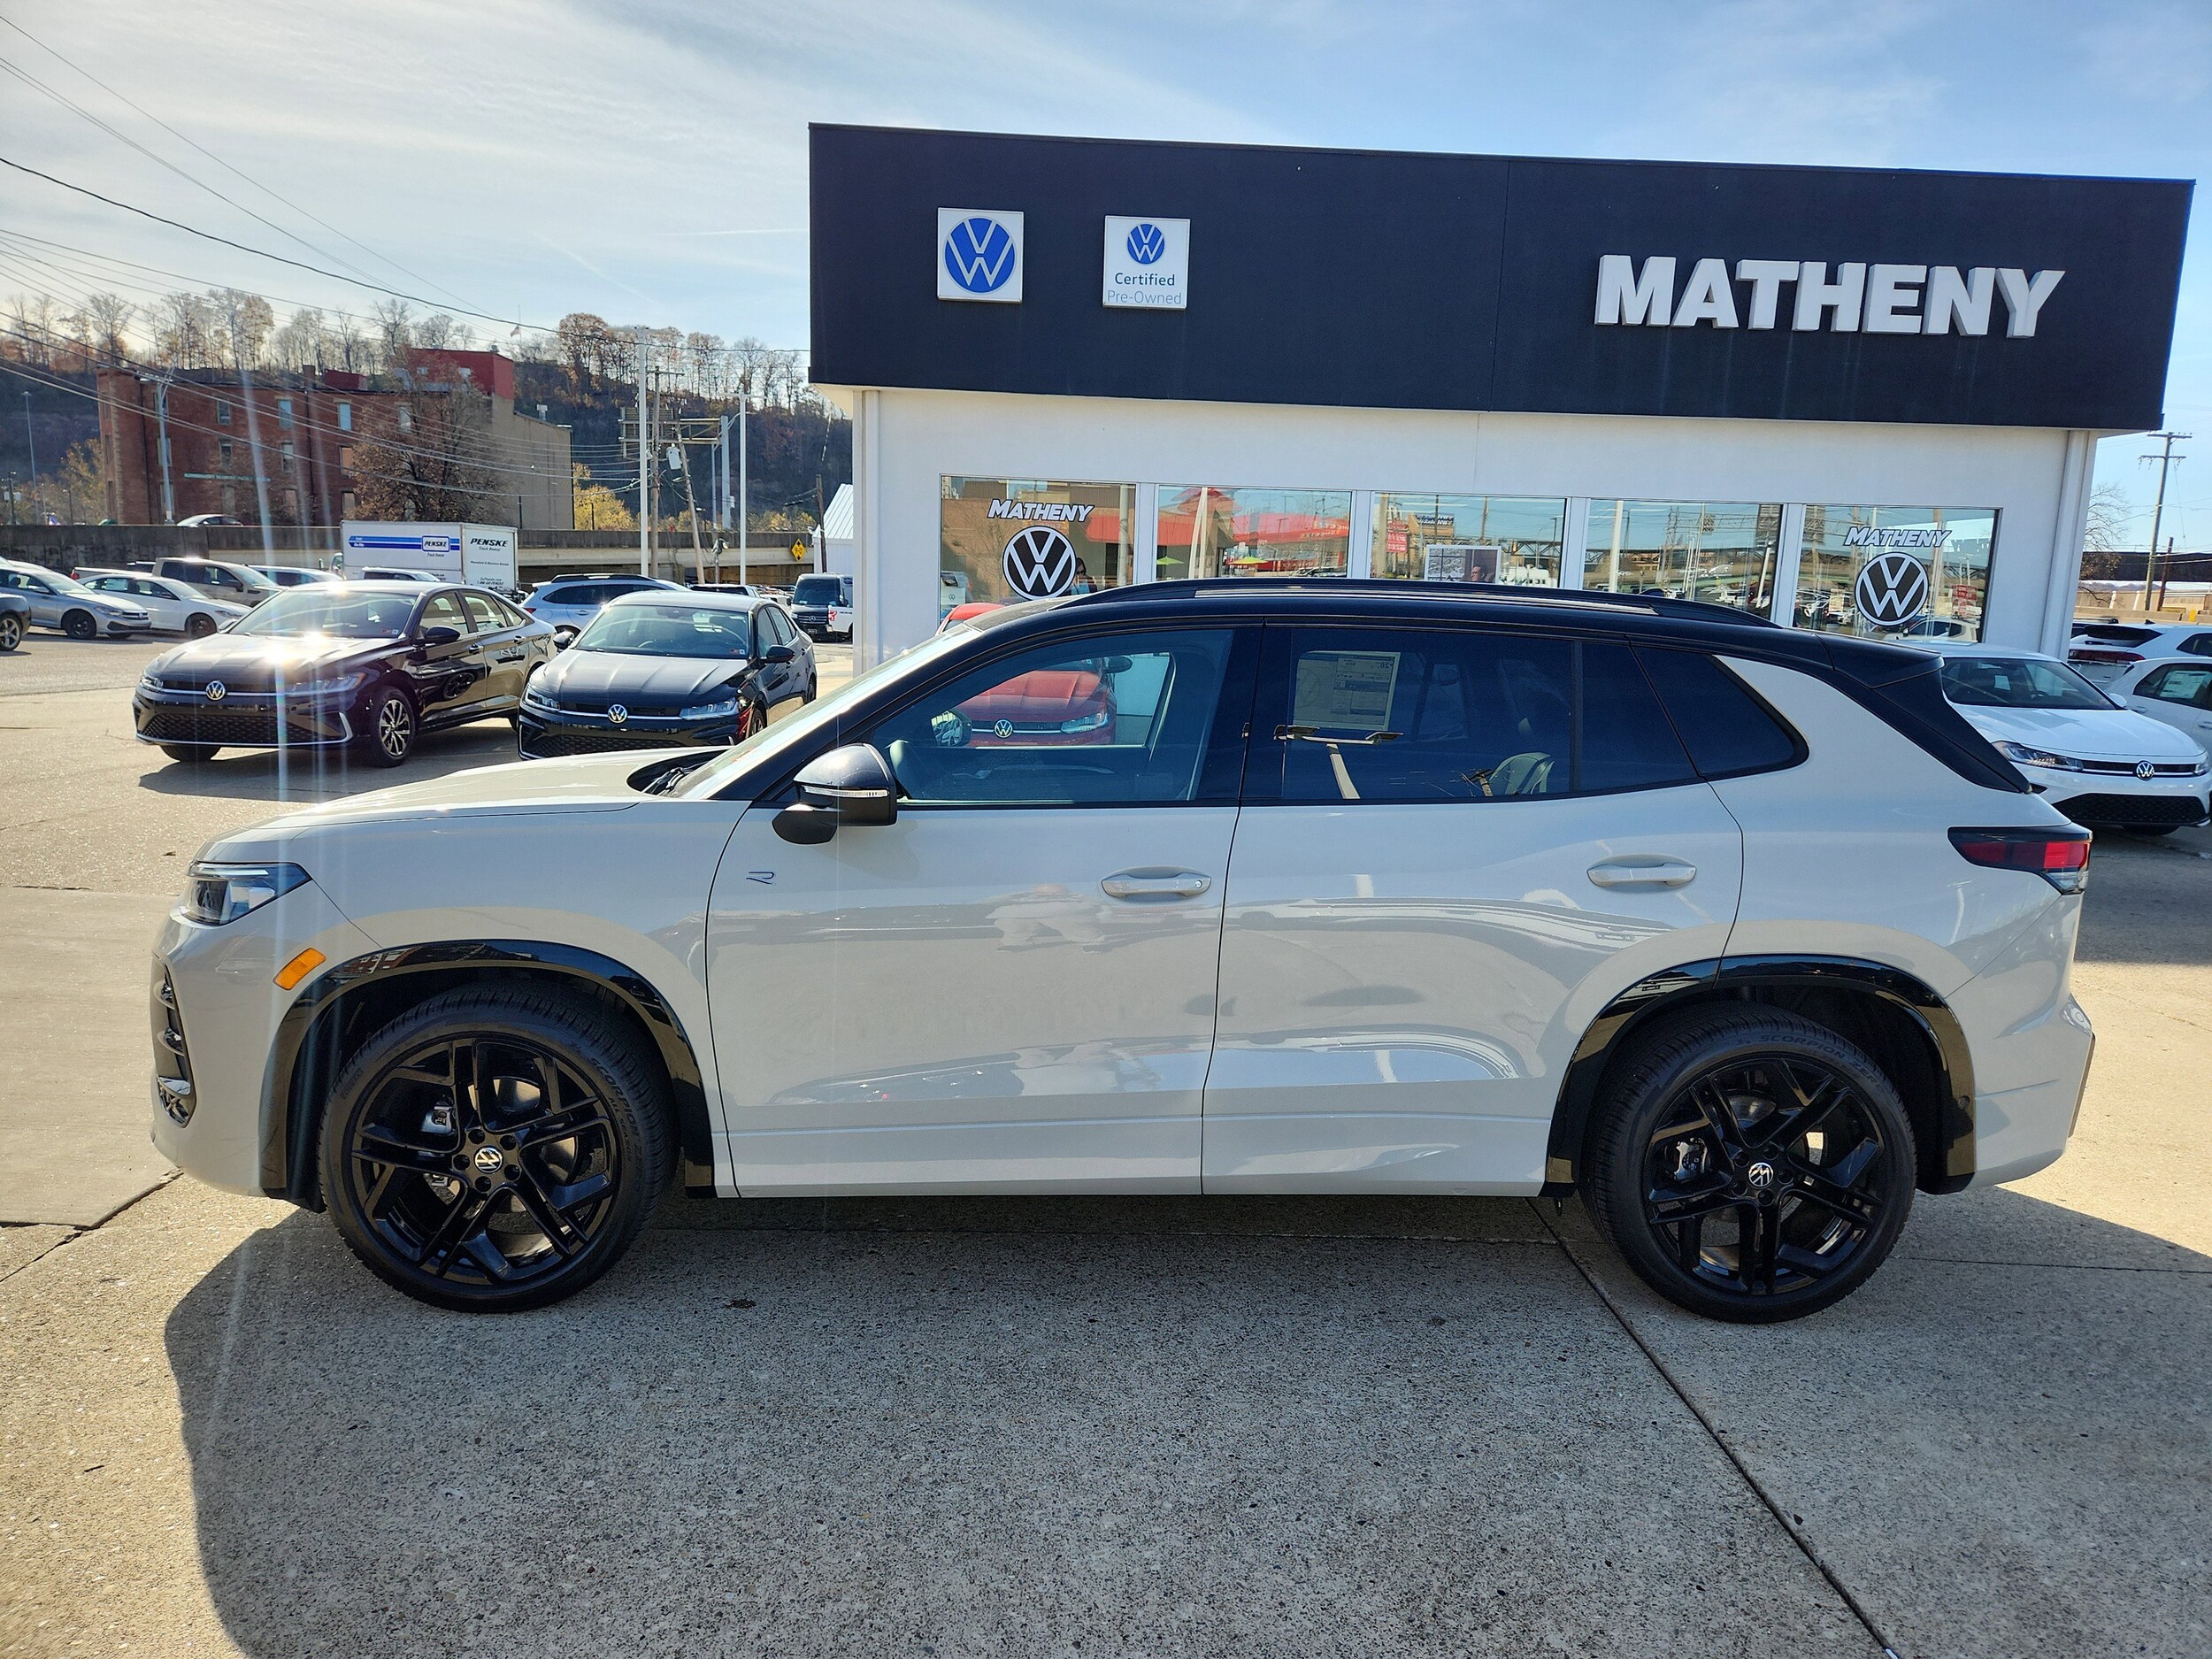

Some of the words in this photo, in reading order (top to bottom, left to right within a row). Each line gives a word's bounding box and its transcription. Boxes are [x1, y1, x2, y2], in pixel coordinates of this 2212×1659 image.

[1114, 272, 1175, 287] Certified
[1107, 289, 1182, 305] Pre-Owned
[1594, 254, 2066, 339] MATHENY
[987, 498, 1095, 522] MATHENY
[470, 538, 509, 547] PENSKE
[1843, 526, 1952, 548] MATHENY
[1760, 1033, 1847, 1059] SCORPION
[589, 1056, 641, 1139] SCORPION
